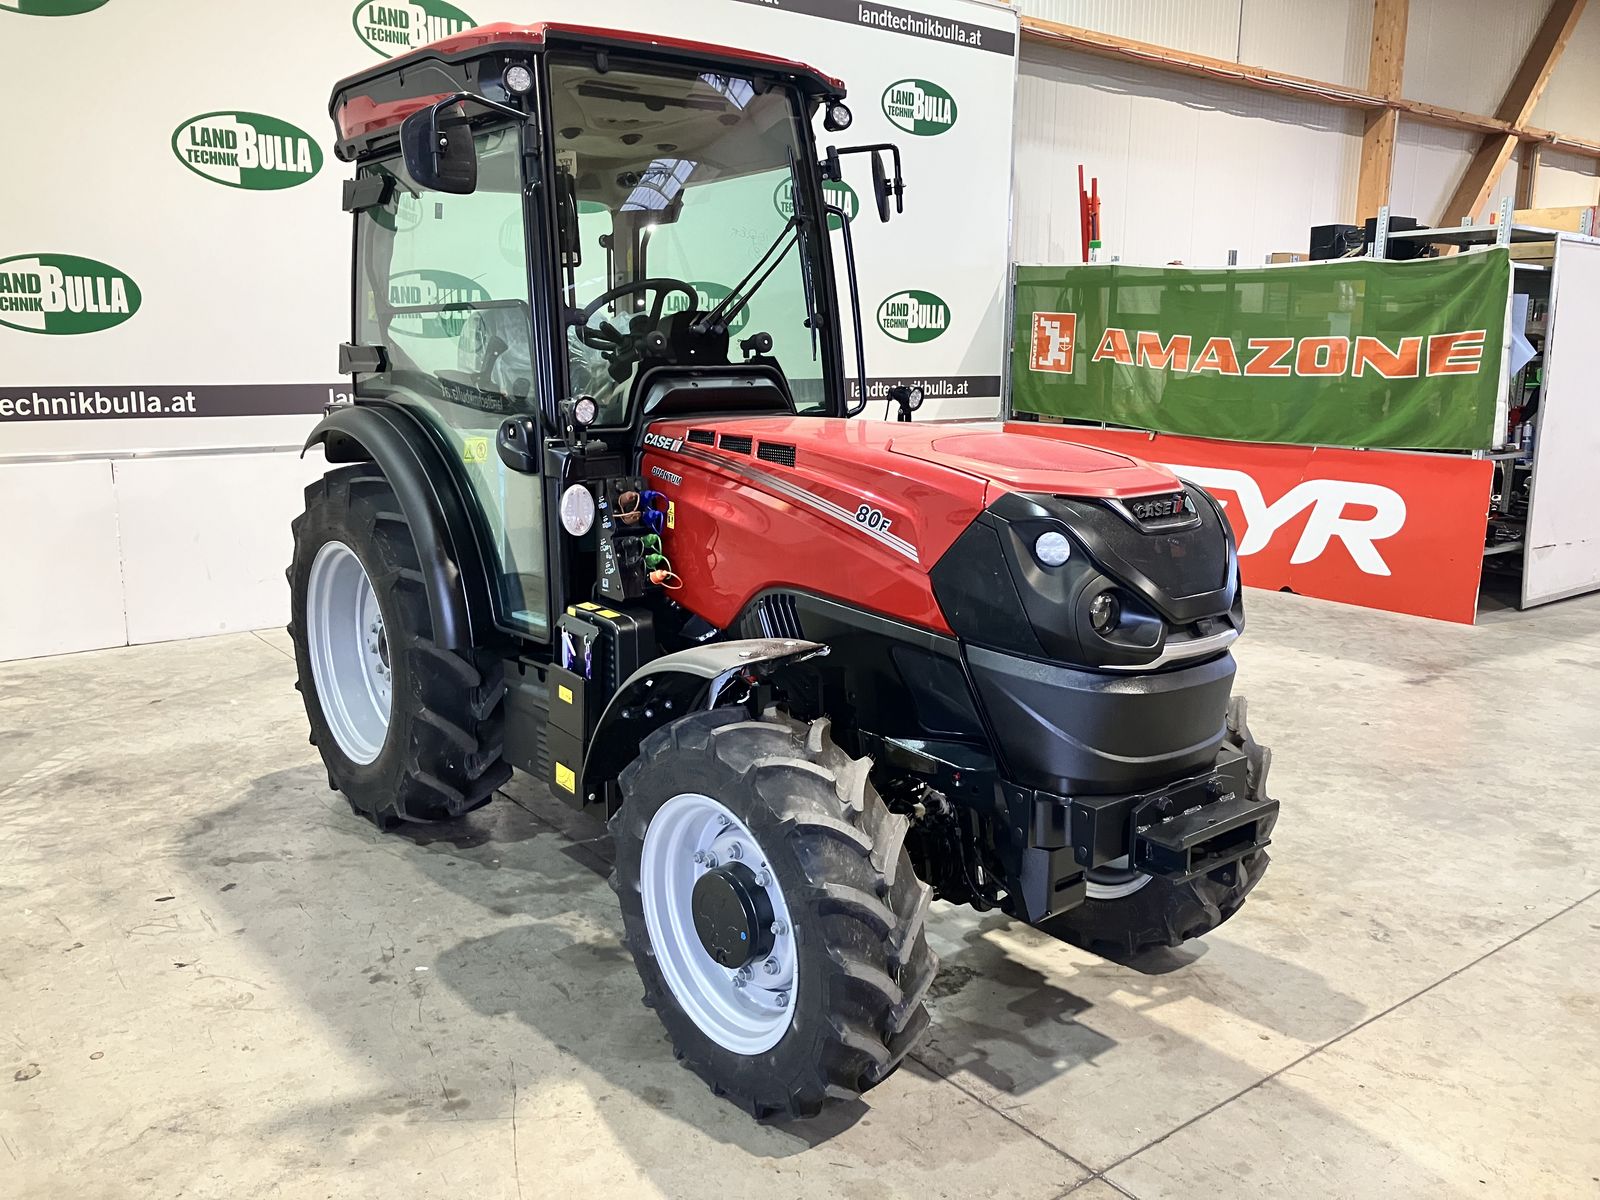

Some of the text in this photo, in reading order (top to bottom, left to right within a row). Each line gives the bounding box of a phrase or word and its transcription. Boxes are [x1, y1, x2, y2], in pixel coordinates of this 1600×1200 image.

[369, 5, 409, 29] LAND
[858, 4, 982, 46] landtechnikbulla.at
[364, 26, 410, 46] TECHNIK
[891, 89, 914, 106] LAND
[914, 87, 951, 124] BULLA
[888, 105, 914, 118] TECHNIK
[190, 126, 238, 150] LAND
[237, 122, 313, 174] BULLA
[186, 149, 240, 167] TECHNIK
[0, 273, 41, 294] AND
[41, 266, 129, 313] BULLA
[0, 296, 43, 312] CHNIK
[390, 286, 421, 304] AND
[667, 296, 689, 311] LAN
[886, 303, 908, 317] LAND
[908, 298, 945, 329] BULLA
[883, 318, 908, 329] TECHNIK
[1031, 313, 1039, 369] AMAZONE
[1091, 328, 1487, 379] AMAZONE
[0, 391, 197, 416] echnikbulla.at
[644, 432, 673, 450] CASE
[651, 465, 683, 487] QUANTUM
[1132, 502, 1172, 519] CASE
